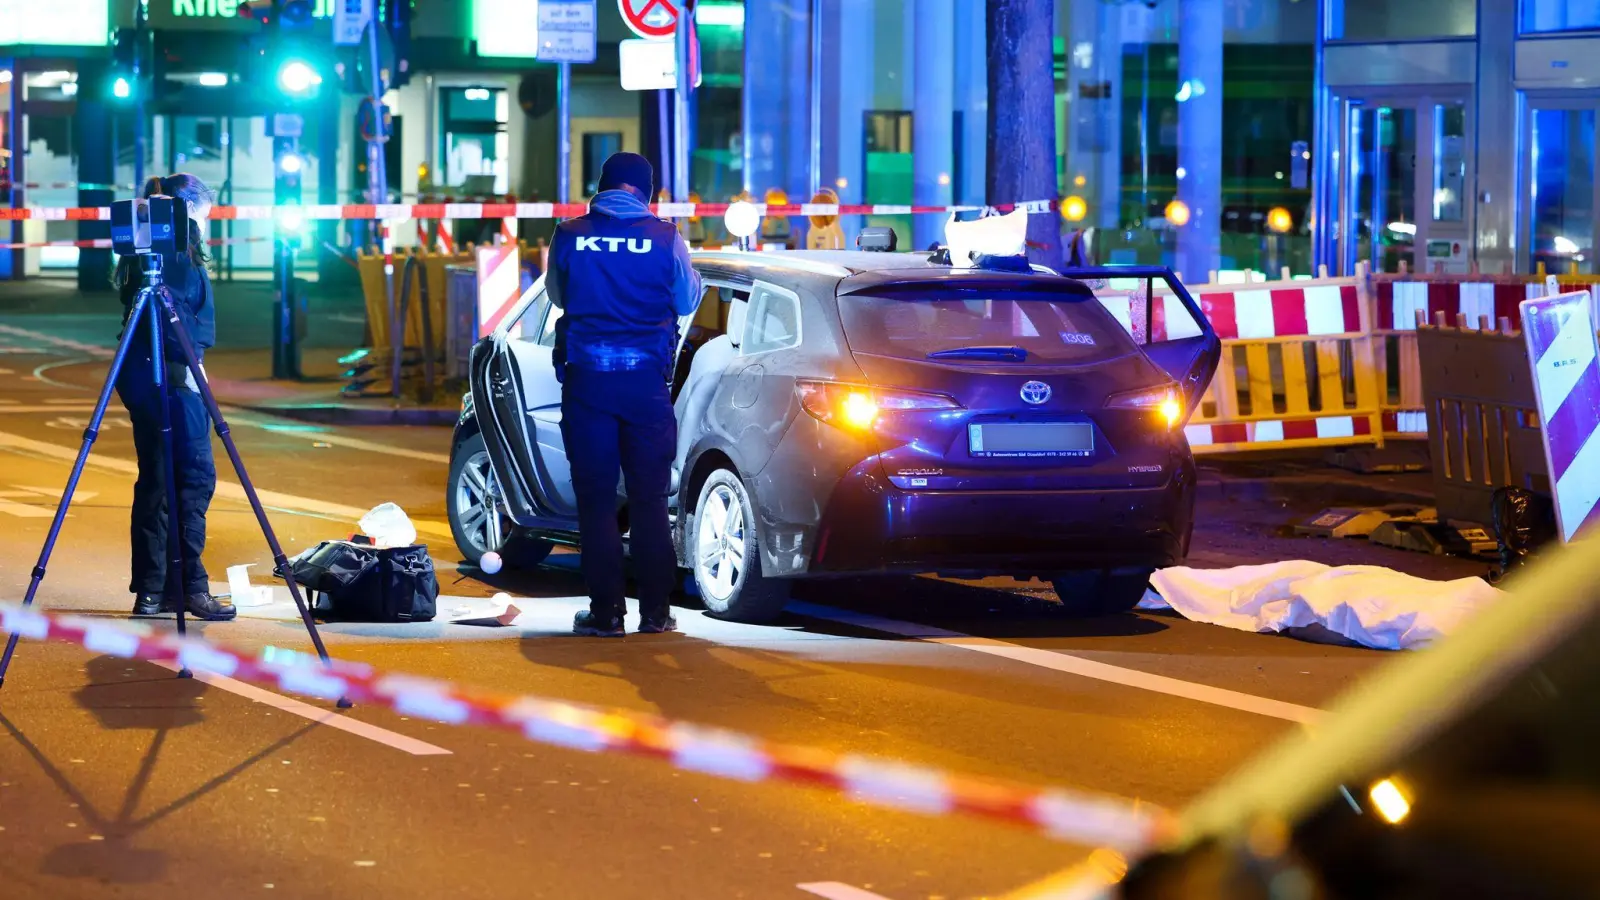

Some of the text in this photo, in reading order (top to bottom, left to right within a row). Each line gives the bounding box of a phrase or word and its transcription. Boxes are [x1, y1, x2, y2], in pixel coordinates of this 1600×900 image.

[575, 236, 652, 254] KTU
[1062, 333, 1094, 345] 1306
[1127, 465, 1162, 473] HYBRID
